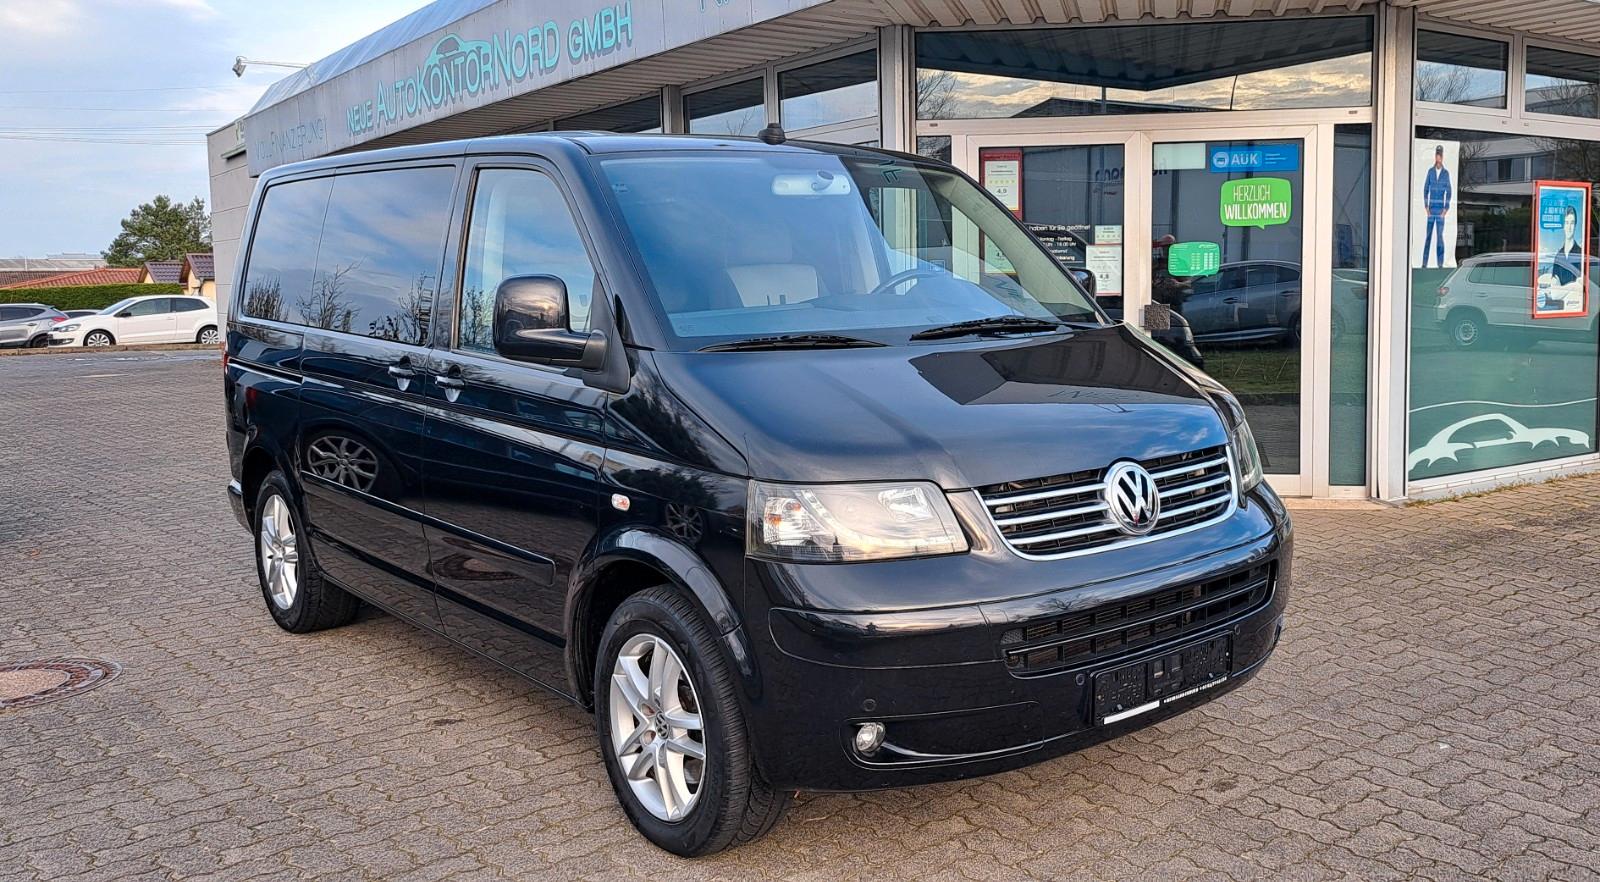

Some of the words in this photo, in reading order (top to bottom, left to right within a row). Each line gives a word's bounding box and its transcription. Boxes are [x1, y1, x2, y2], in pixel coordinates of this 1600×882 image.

[346, 100, 373, 132] NEUE
[567, 0, 633, 60] GMBH
[1233, 184, 1271, 201] HERZLICH
[1224, 202, 1287, 219] WILLKOMMEN
